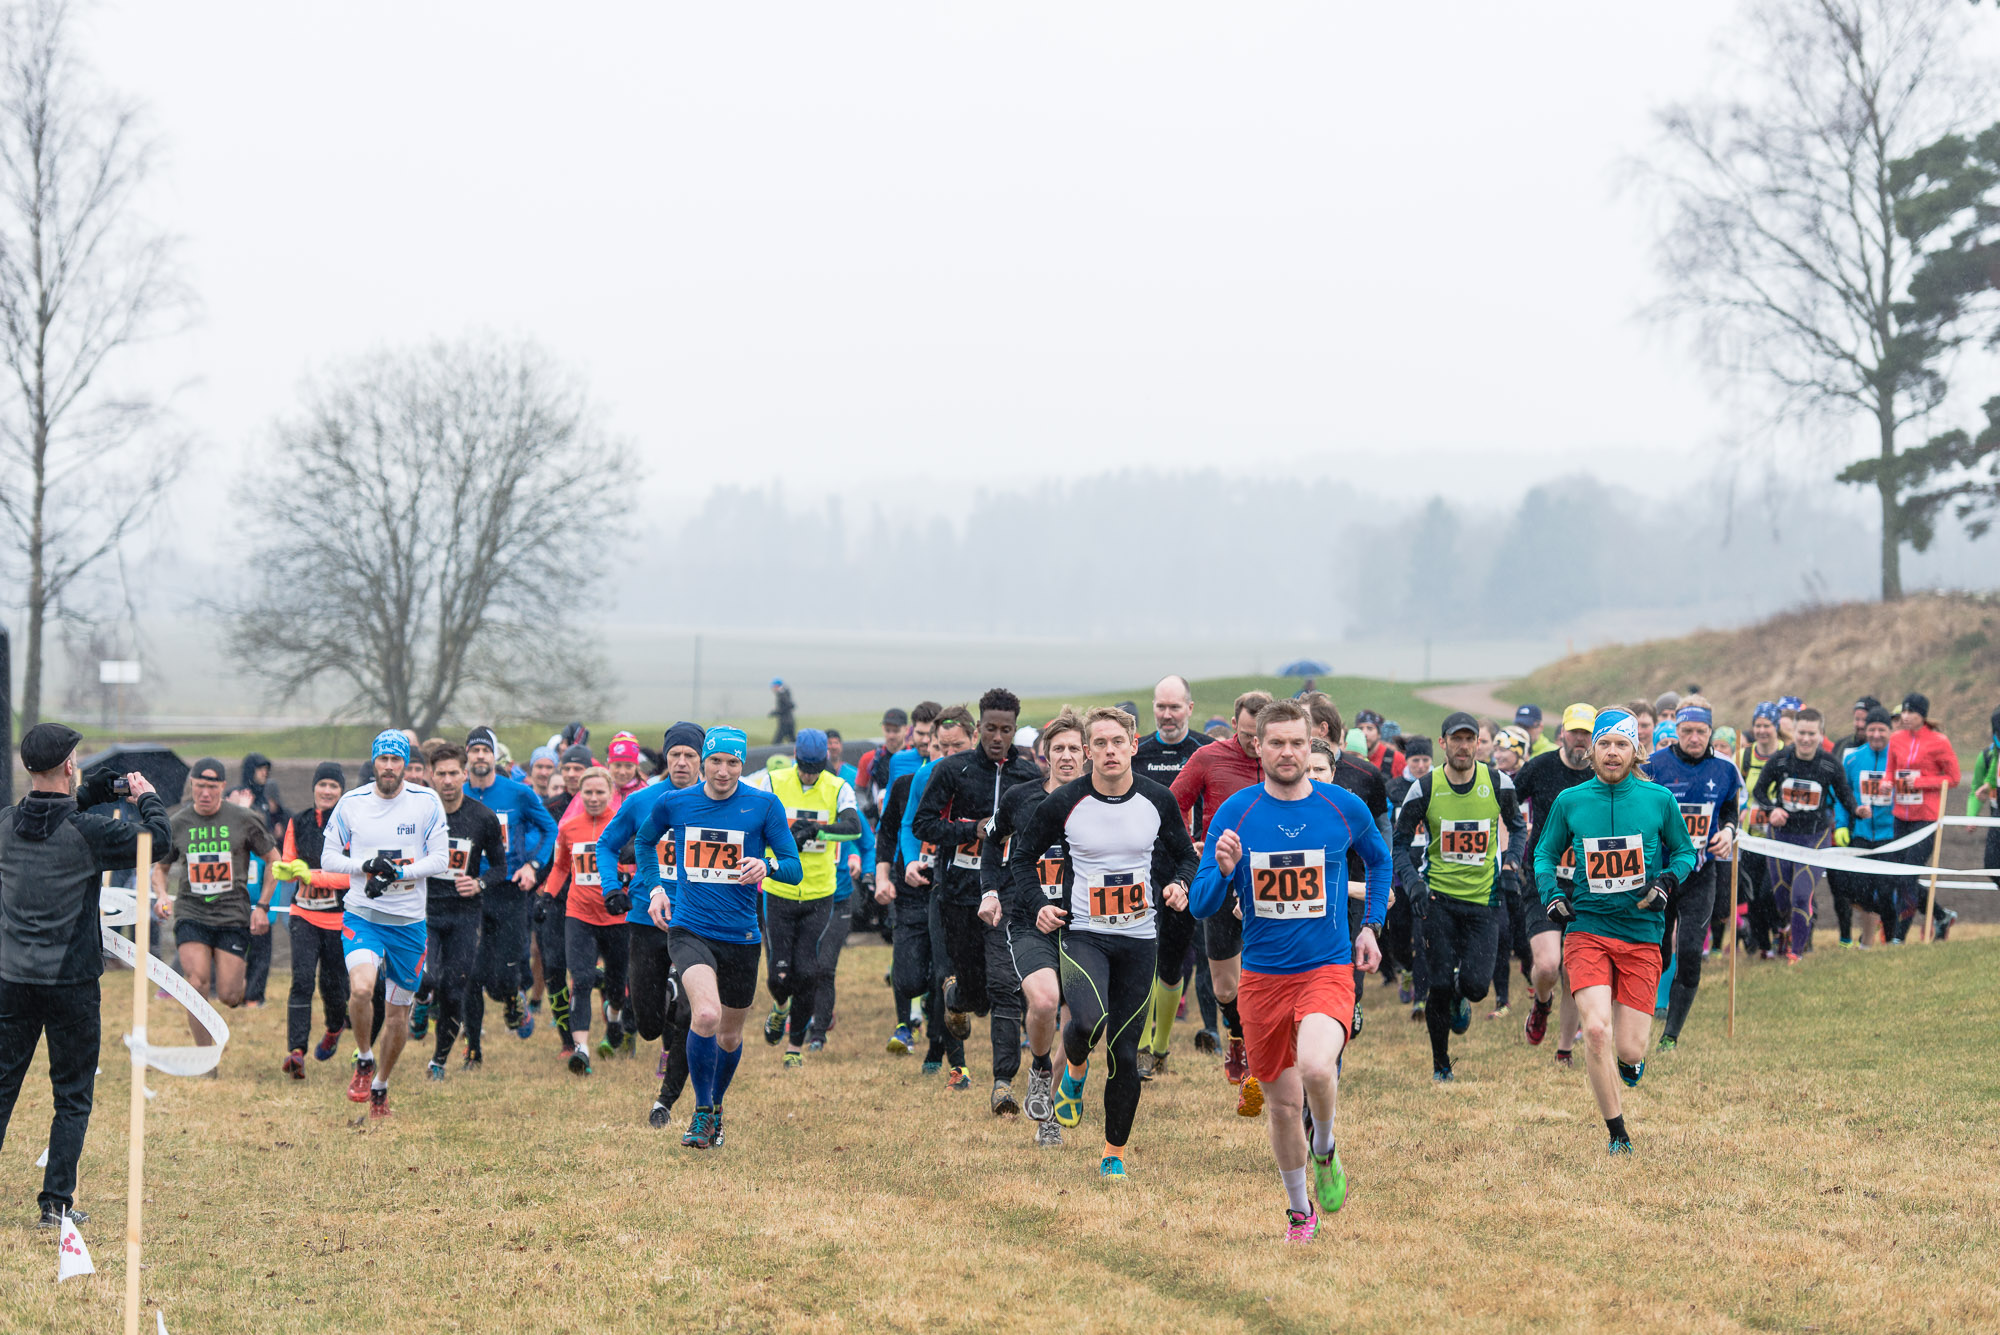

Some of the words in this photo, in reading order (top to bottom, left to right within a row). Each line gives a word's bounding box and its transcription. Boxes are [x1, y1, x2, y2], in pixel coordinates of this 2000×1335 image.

[188, 825, 230, 840] THIS
[397, 824, 415, 834] trail
[1685, 815, 1708, 836] 09
[187, 840, 231, 854] GOOD
[1445, 832, 1487, 854] 139
[576, 853, 598, 873] 16
[690, 842, 738, 869] 173
[1590, 849, 1640, 878] 204
[192, 863, 229, 882] 142
[1037, 859, 1065, 885] 17
[1257, 867, 1320, 901] 203
[1093, 884, 1144, 915] 119
